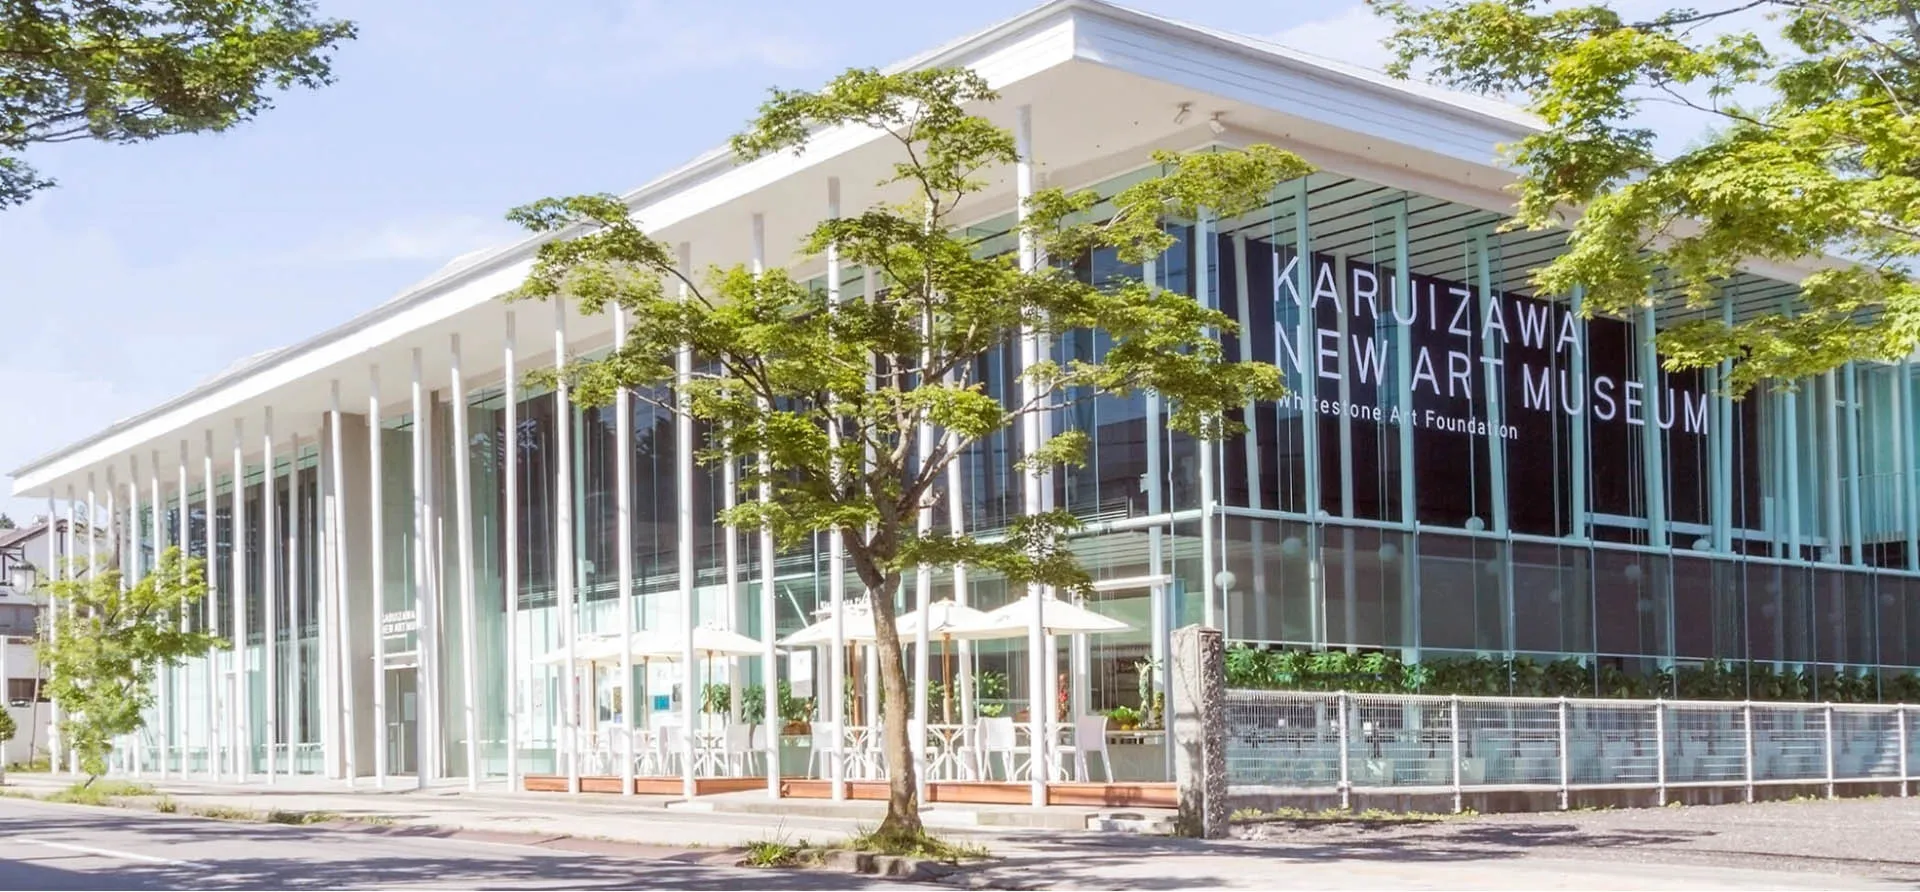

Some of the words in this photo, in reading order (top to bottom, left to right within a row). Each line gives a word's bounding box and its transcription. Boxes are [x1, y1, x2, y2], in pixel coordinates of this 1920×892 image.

[1273, 251, 1583, 356] KARUIZAWA
[1275, 320, 1389, 387] NEW
[1410, 346, 1504, 403] ART
[1522, 363, 1709, 435] MUSEUM
[1390, 404, 1418, 426] Art
[1424, 409, 1518, 440] Foundation
